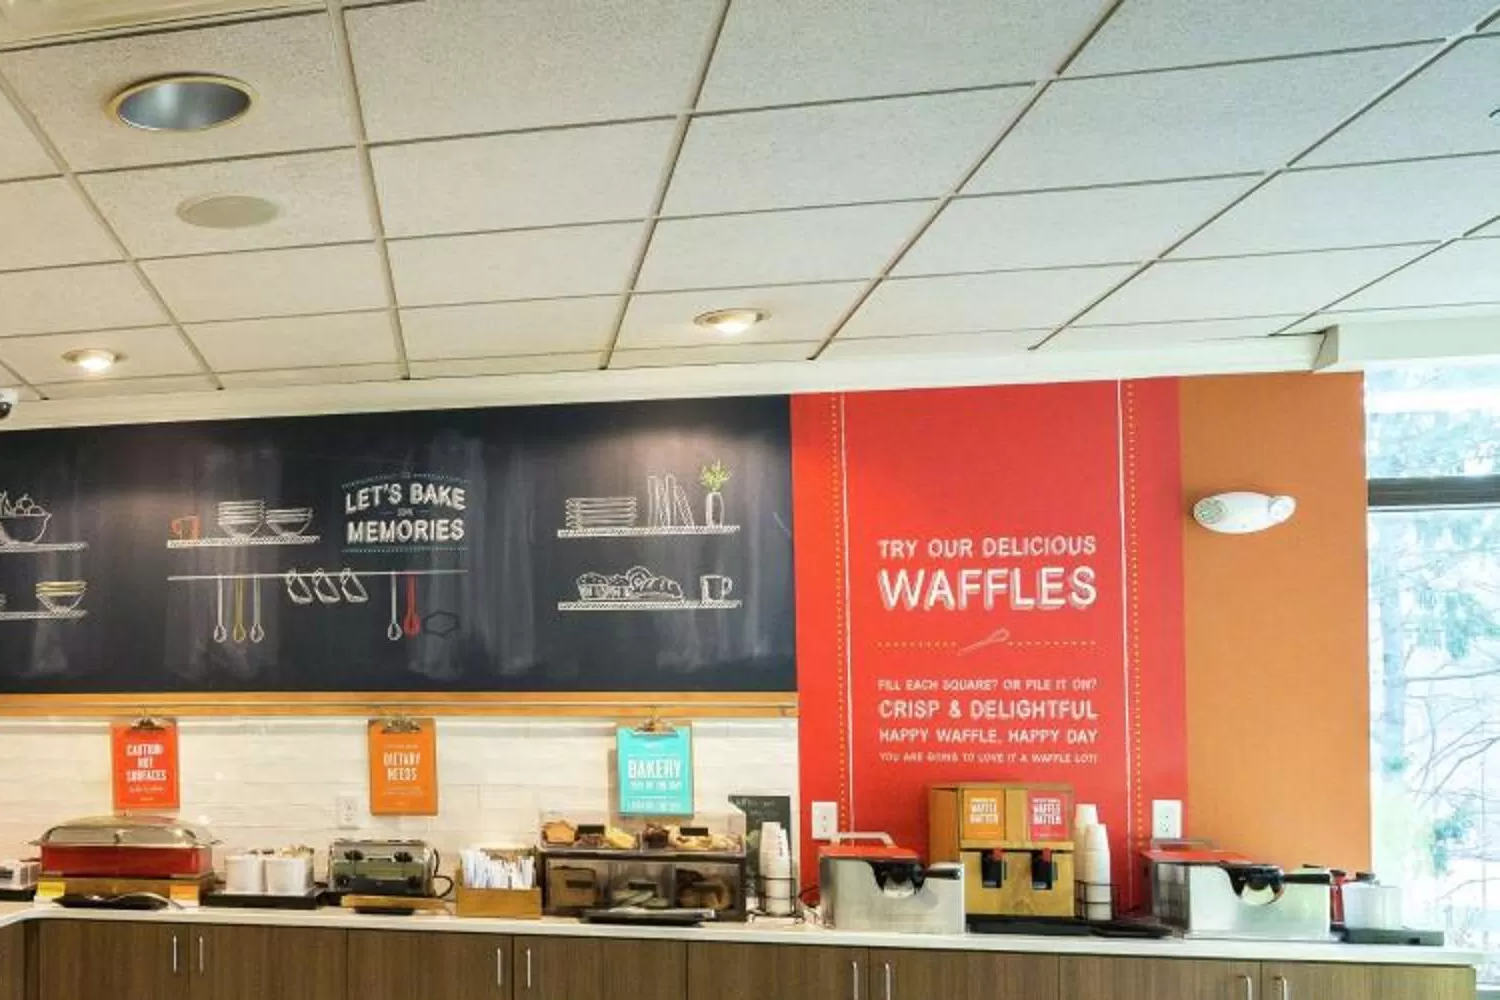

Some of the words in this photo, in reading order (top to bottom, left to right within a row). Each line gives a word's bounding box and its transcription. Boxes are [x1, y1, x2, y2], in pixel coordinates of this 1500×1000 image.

[345, 483, 403, 515] LET'S
[409, 482, 467, 511] BAKE
[347, 518, 466, 545] MEMORIES
[878, 539, 918, 559] TRY
[928, 538, 974, 558] OUR
[982, 535, 1097, 557] DELICIOUS
[877, 565, 1098, 612] WAFFLES
[877, 679, 901, 691] FILL
[905, 679, 938, 691] EACH
[942, 679, 999, 692] SQUARE?
[1003, 679, 1020, 690] OR
[1026, 679, 1051, 690] PILE
[1055, 679, 1066, 690] IT
[878, 699, 941, 719] CRISP
[948, 699, 963, 718] &
[970, 699, 1100, 720] DELIGHTFUL
[879, 728, 929, 743] HAPPY
[1008, 728, 1060, 744] HAPPY
[1067, 728, 1099, 744] DAY
[383, 751, 421, 767] DIETARY
[879, 752, 901, 762] YOU
[903, 752, 923, 762] ARE
[963, 753, 975, 762] TO
[978, 753, 1004, 762] LOVE
[1008, 753, 1017, 762] IT
[1020, 753, 1028, 762] A
[1031, 753, 1071, 763] WAFFLE
[387, 767, 418, 781] NEEDS
[628, 759, 681, 779] BAKERY
